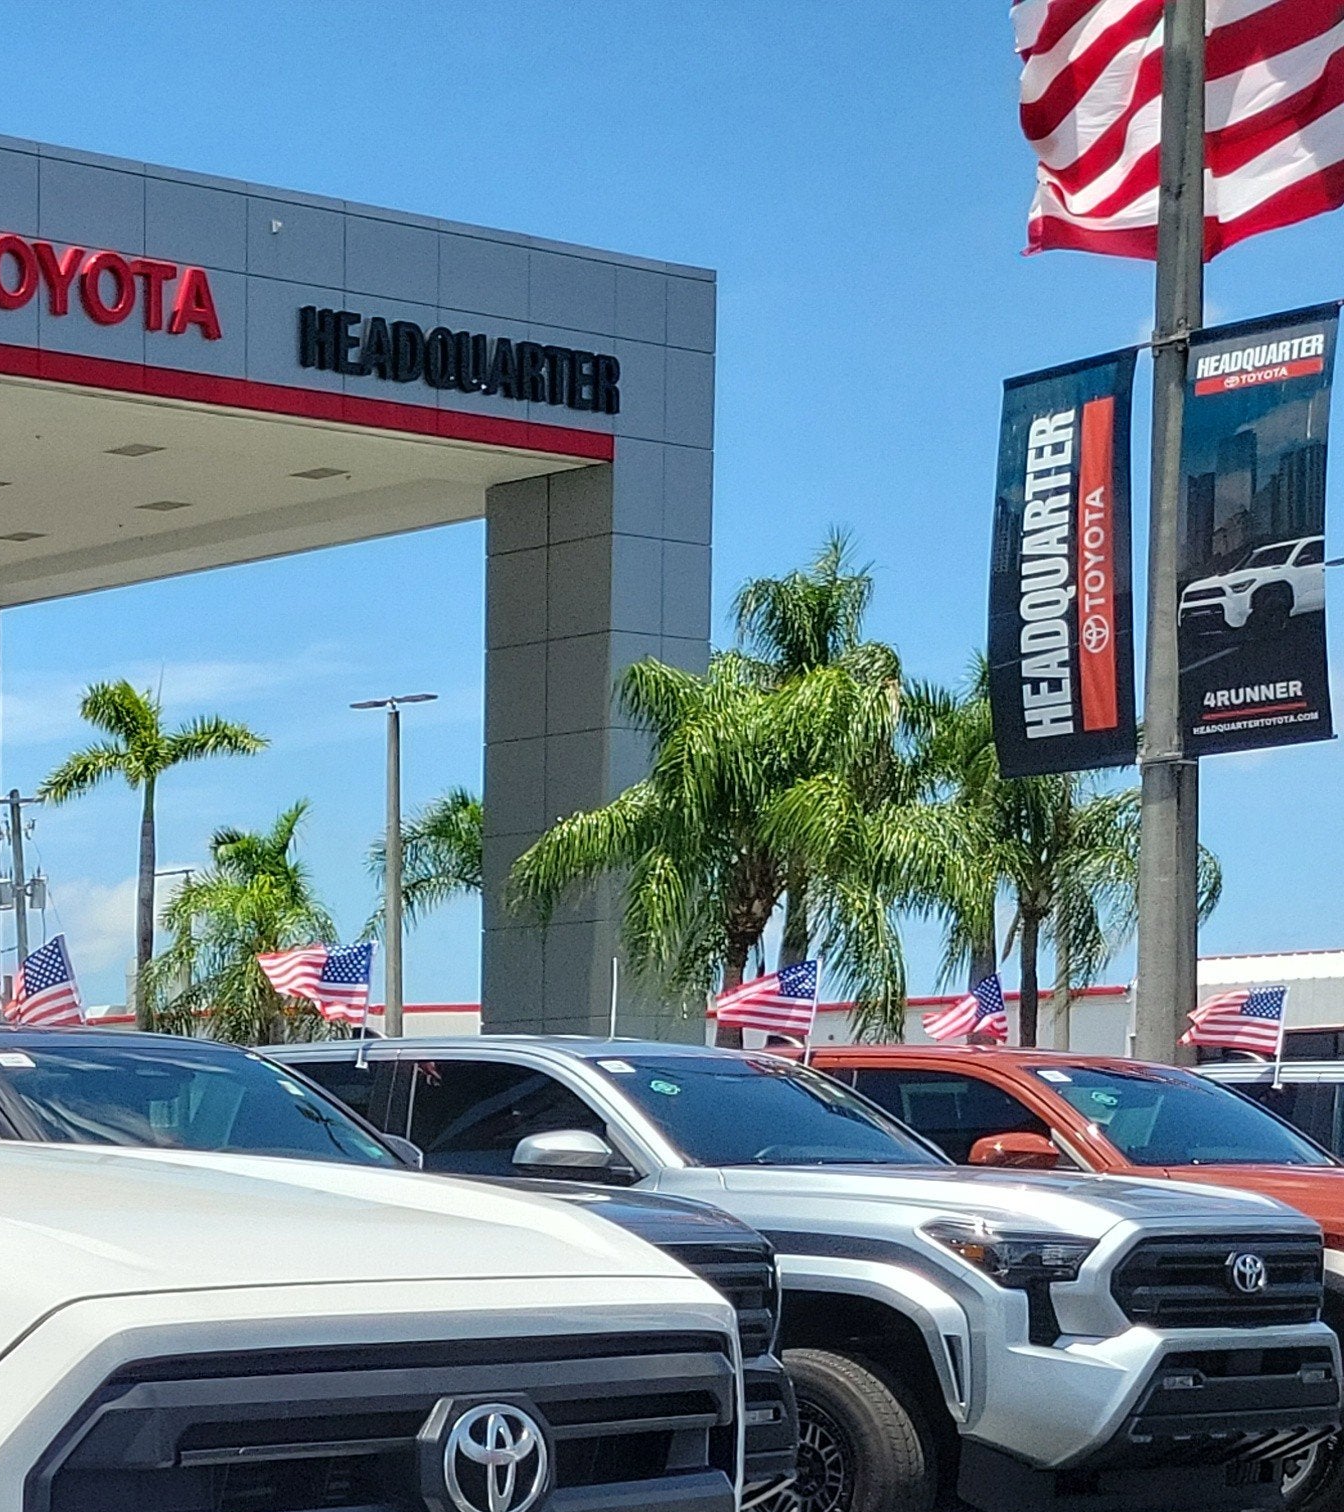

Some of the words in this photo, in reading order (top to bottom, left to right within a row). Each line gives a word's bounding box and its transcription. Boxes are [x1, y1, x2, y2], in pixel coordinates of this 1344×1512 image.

[299, 305, 620, 414] HEADQUARTER
[1196, 334, 1325, 379] HEADQUARTER
[1240, 367, 1289, 384] TOYOTA
[1083, 486, 1107, 611] TOYOTA
[1020, 408, 1077, 739] HEADQUARTER
[1203, 680, 1303, 708] 4RUNNER
[1192, 711, 1319, 735] HEADQUARTERTOYOTA.COM
